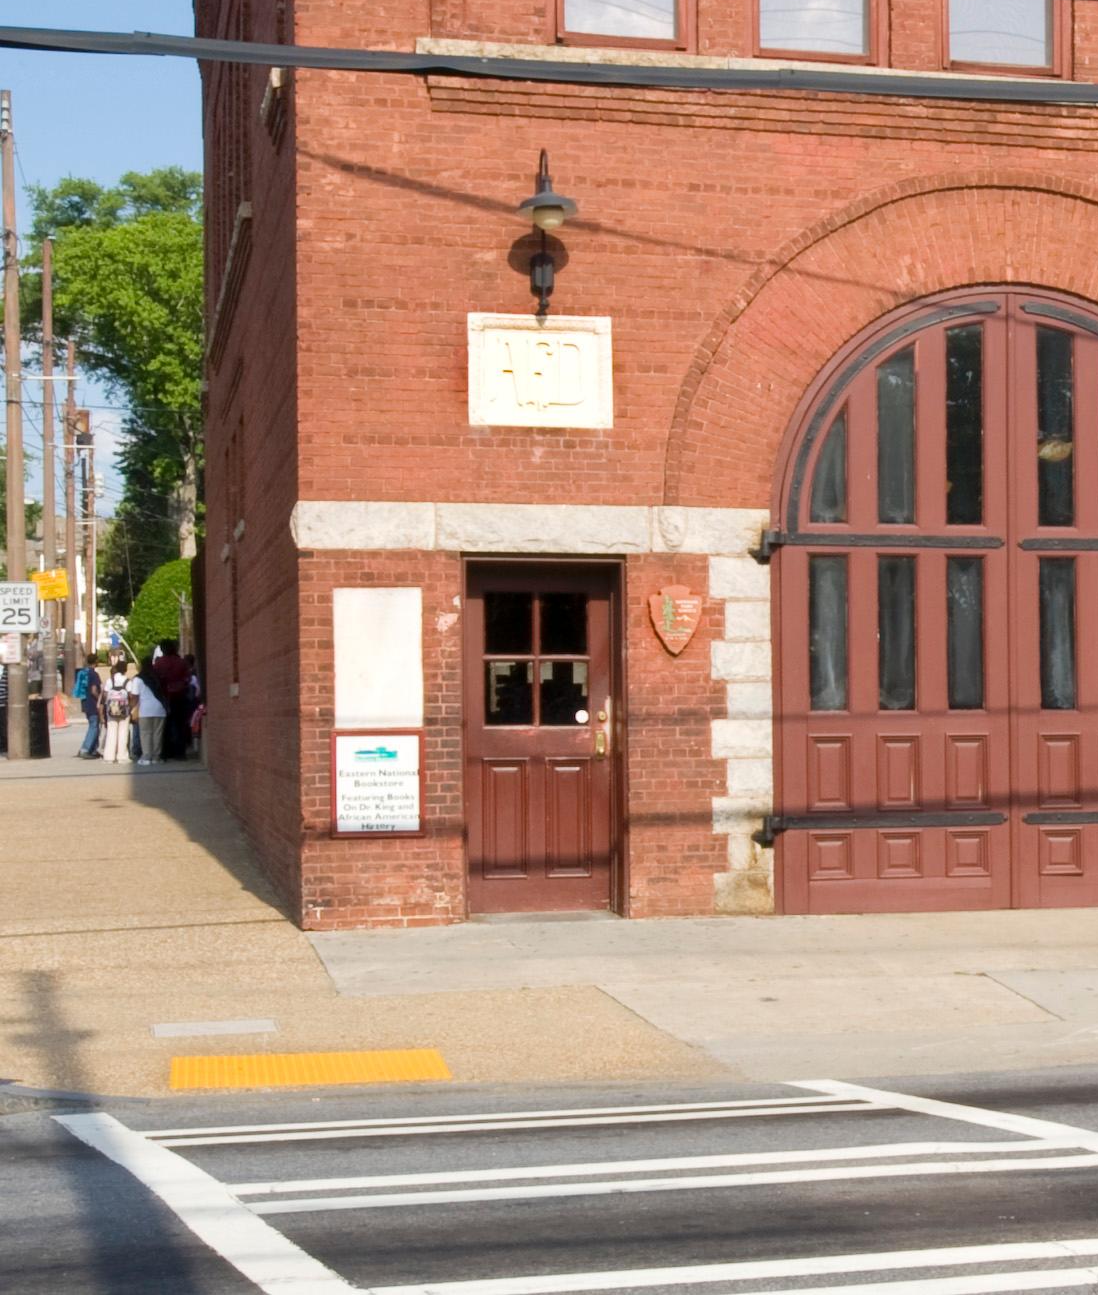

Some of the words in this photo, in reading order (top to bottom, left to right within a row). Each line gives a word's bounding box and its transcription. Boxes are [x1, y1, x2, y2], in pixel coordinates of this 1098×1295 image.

[0, 587, 32, 596] SPEED
[2, 608, 31, 625] 25
[339, 769, 377, 777] Eastern
[353, 779, 404, 788] Bookstore
[341, 793, 385, 803] Featuring
[387, 793, 415, 801] Books
[343, 803, 357, 811] On
[375, 803, 395, 812] King
[338, 813, 373, 821] African
[361, 822, 396, 831] History
